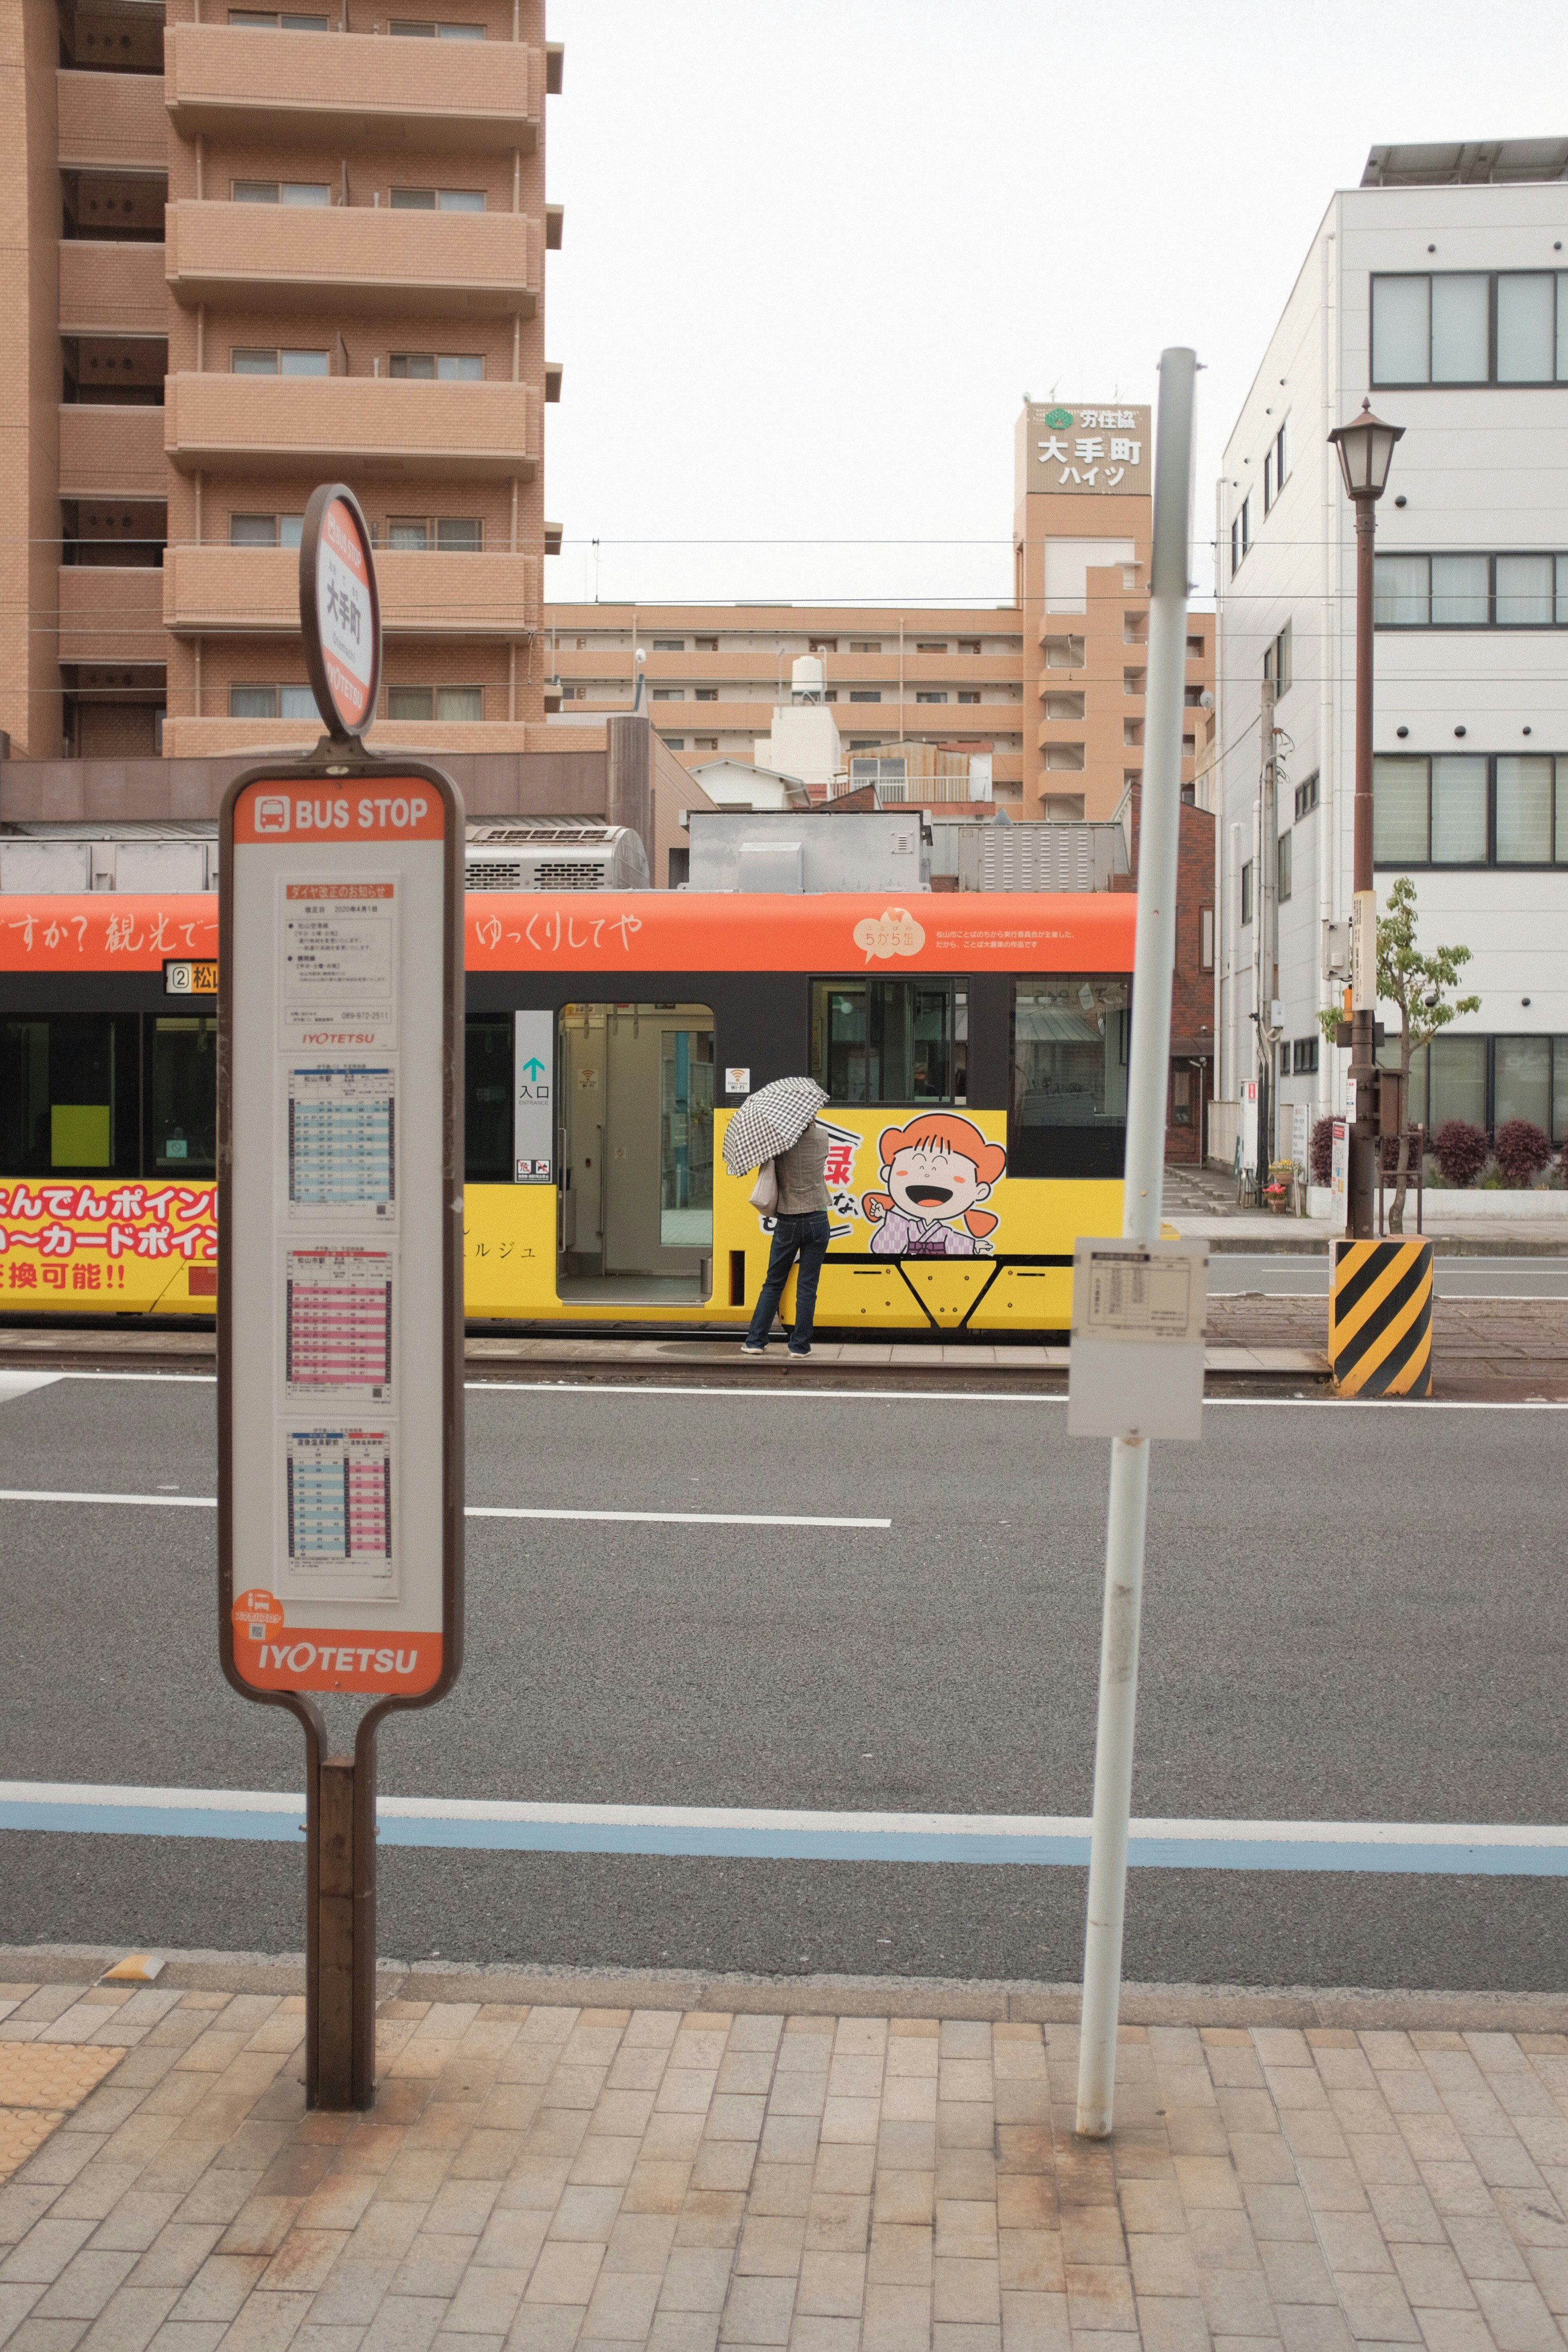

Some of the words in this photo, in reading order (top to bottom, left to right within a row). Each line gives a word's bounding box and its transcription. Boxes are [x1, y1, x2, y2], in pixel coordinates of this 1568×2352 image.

[1080, 410, 1136, 429] 労住協
[1038, 435, 1142, 465] 大手町
[1058, 467, 1124, 486] ハイツ
[327, 578, 362, 646] 大手町
[327, 662, 363, 710] IYOTETSU
[296, 799, 350, 829] BUS
[358, 798, 428, 828] STOP
[0, 914, 88, 952] すか?
[475, 911, 642, 951] ゆっくりしてや
[177, 970, 185, 985] 2
[302, 1032, 375, 1045] IYOTETSU
[520, 1085, 549, 1098] 入口
[0, 1185, 218, 1220] んでんポイン
[464, 1242, 535, 1258] ルジュ
[0, 1262, 125, 1290] 換可能!!
[259, 1642, 418, 1674] IYOTETSU
